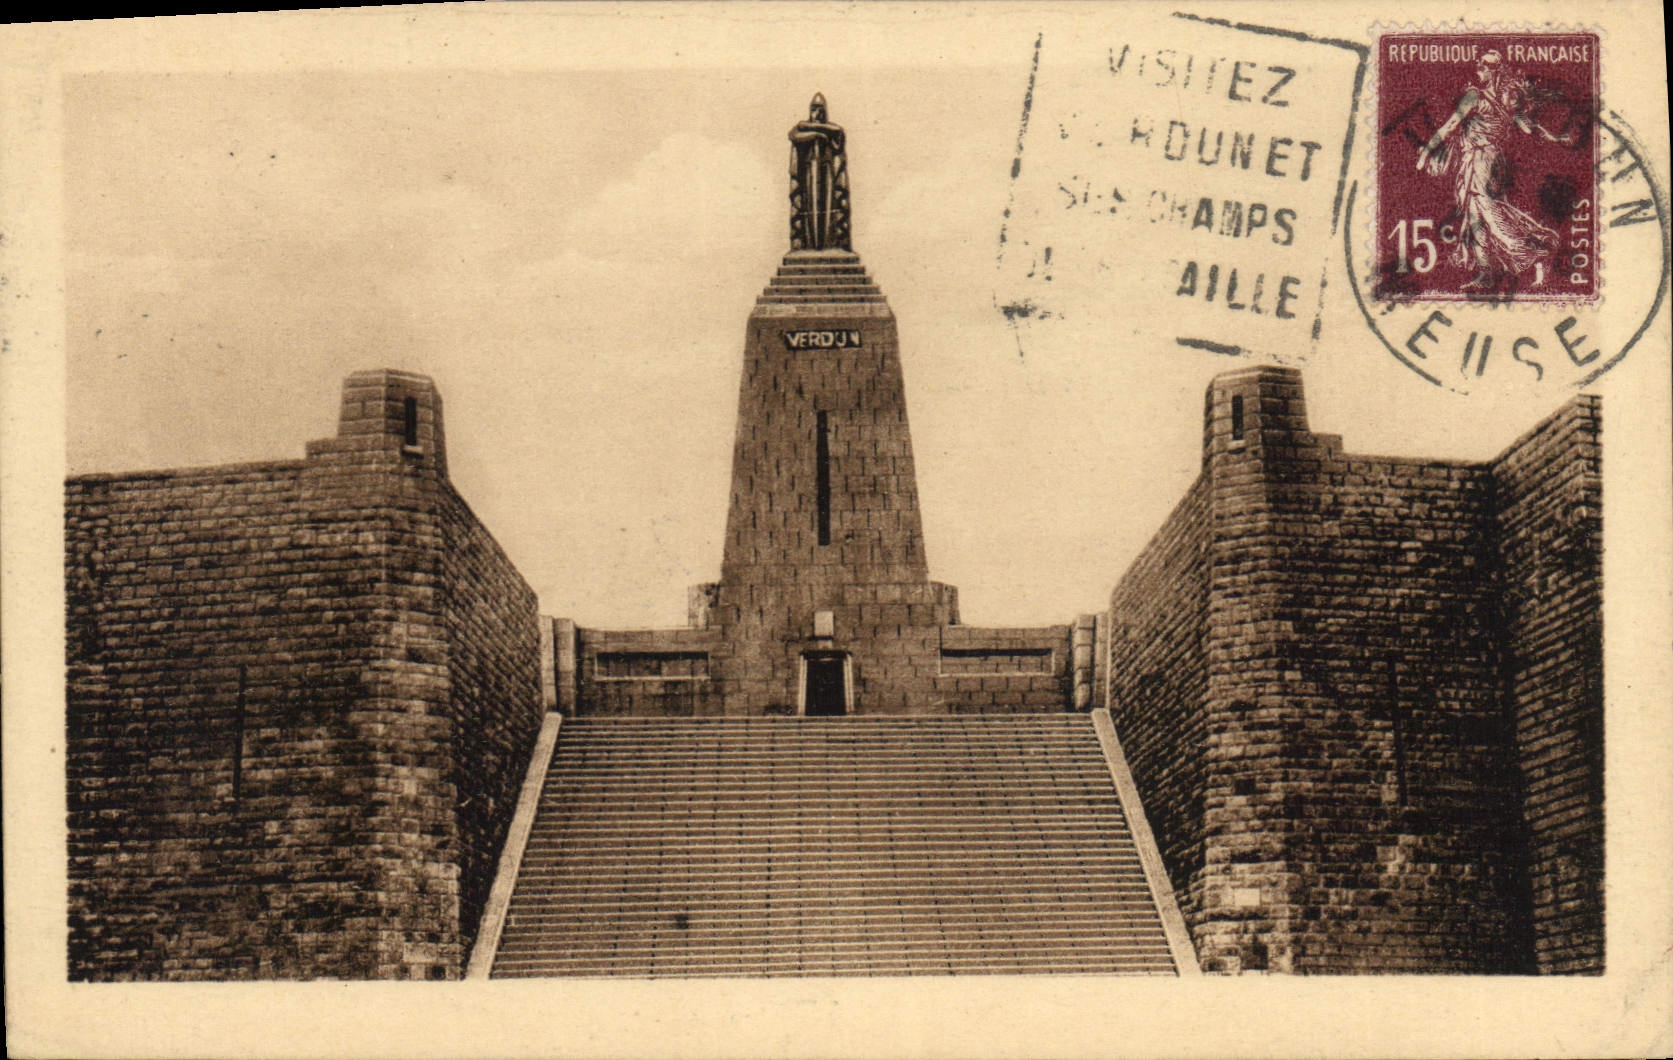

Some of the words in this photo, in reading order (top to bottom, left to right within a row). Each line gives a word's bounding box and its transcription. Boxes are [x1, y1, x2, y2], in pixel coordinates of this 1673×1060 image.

[1506, 43, 1590, 64] FRANÇAISE
[1388, 218, 1438, 274] 15
[1570, 198, 1590, 285] POSTES
[786, 331, 860, 348] VERDUN
